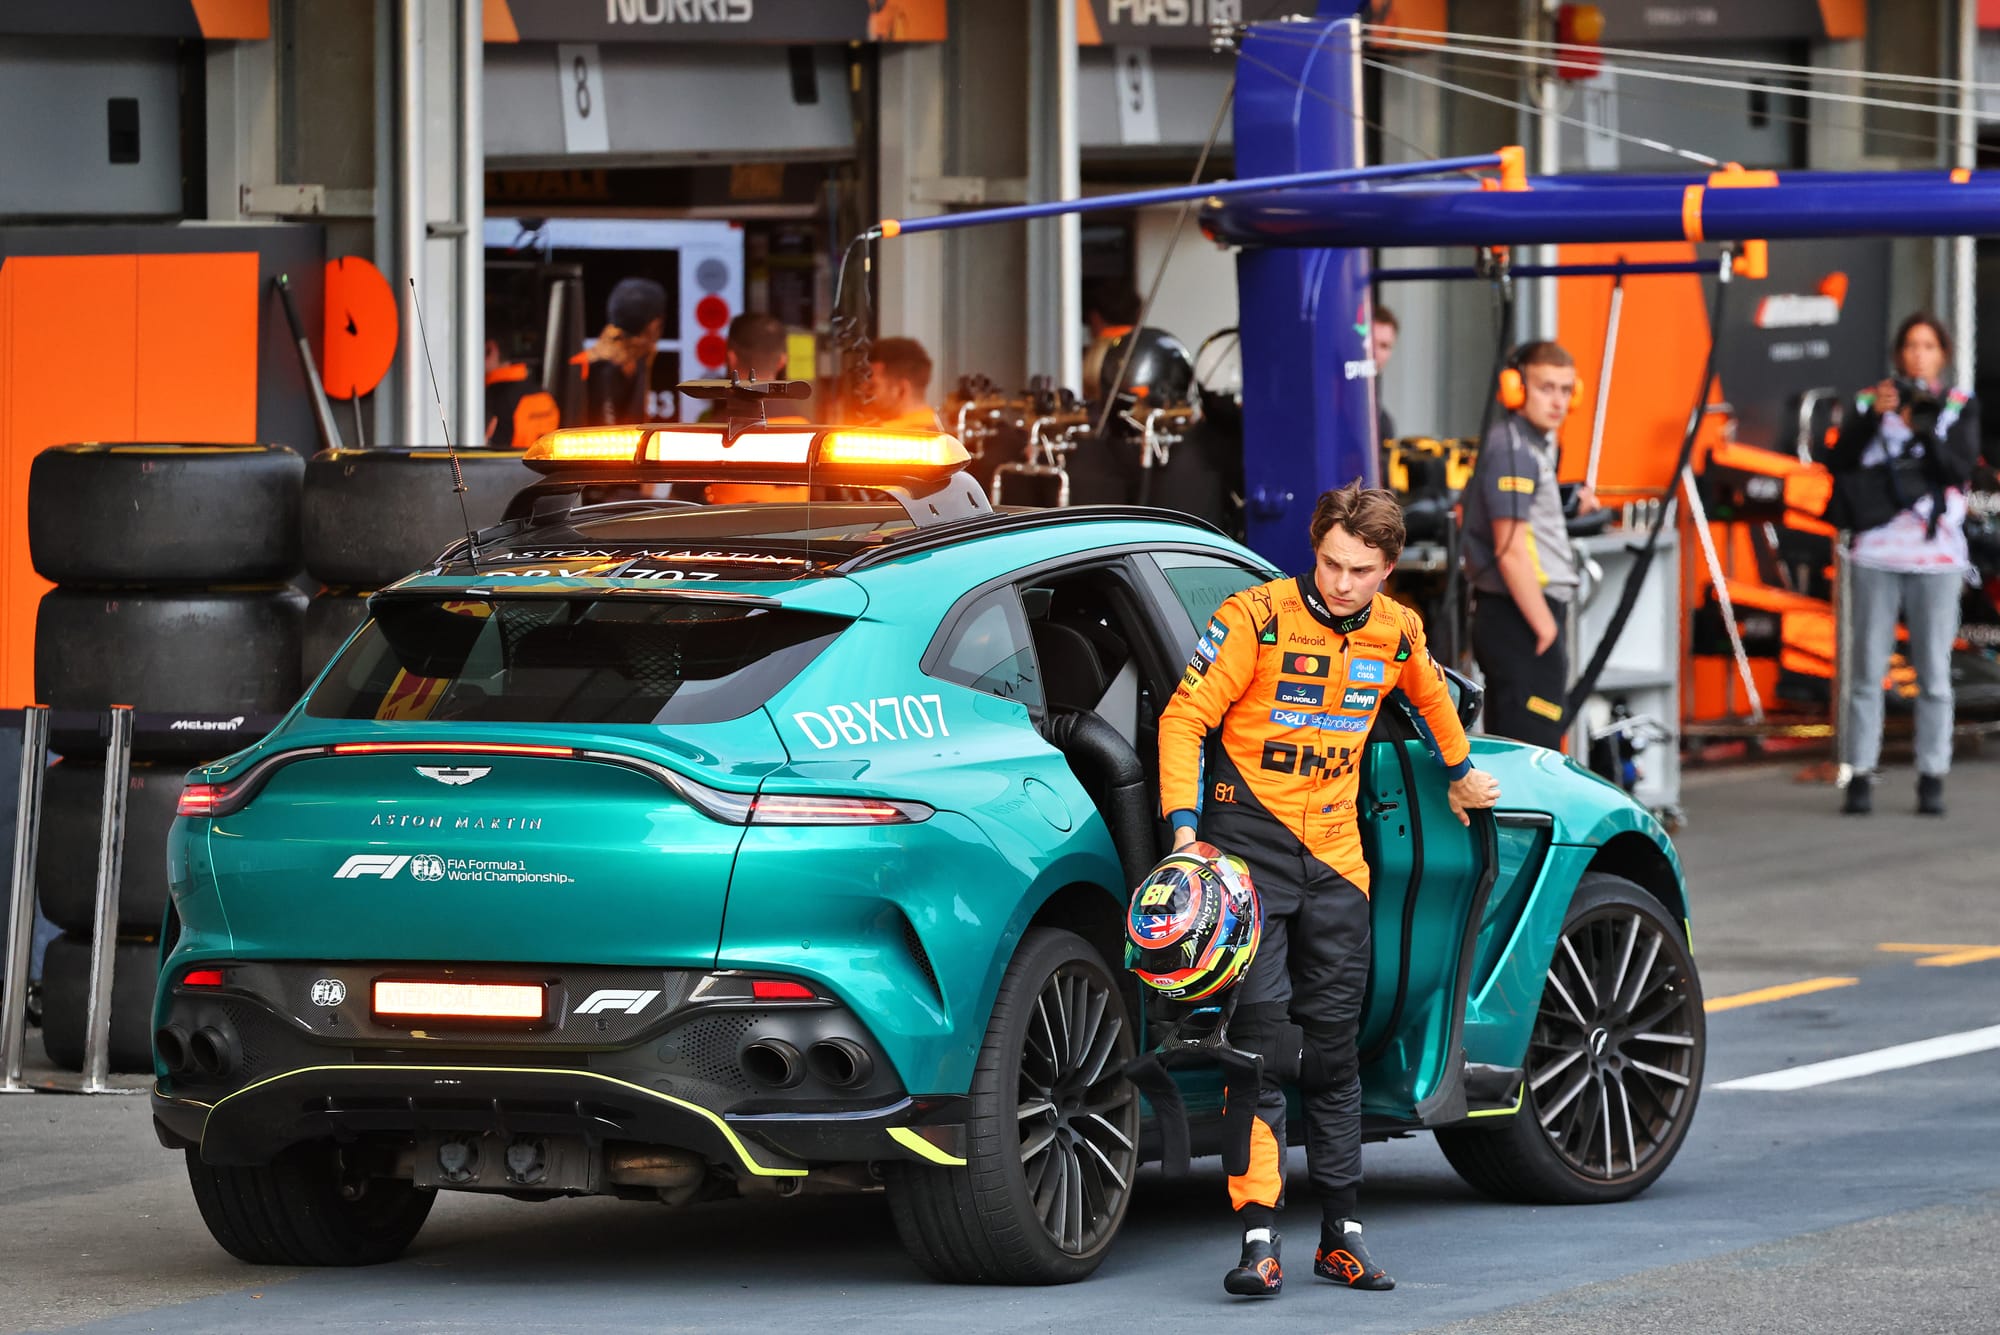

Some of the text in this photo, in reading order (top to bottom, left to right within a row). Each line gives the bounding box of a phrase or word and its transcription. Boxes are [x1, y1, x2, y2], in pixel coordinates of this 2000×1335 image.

[607, 0, 754, 25] NORRIS
[573, 54, 591, 119] 8
[488, 549, 794, 565] ASTON MARTIN
[1288, 632, 1326, 647] Android
[1282, 694, 1318, 705] DP WORLD
[1344, 692, 1375, 708] allwyn
[170, 718, 238, 731] McLaren
[792, 694, 950, 750] DBX707
[1274, 711, 1308, 726] DELL
[1214, 782, 1236, 804] 81
[371, 813, 543, 831] ASTON MARTIN
[333, 854, 412, 880] F1
[447, 859, 526, 871] FIA Formula 1
[447, 871, 483, 882] World
[1140, 883, 1178, 906] 81
[573, 989, 661, 1014] F1
